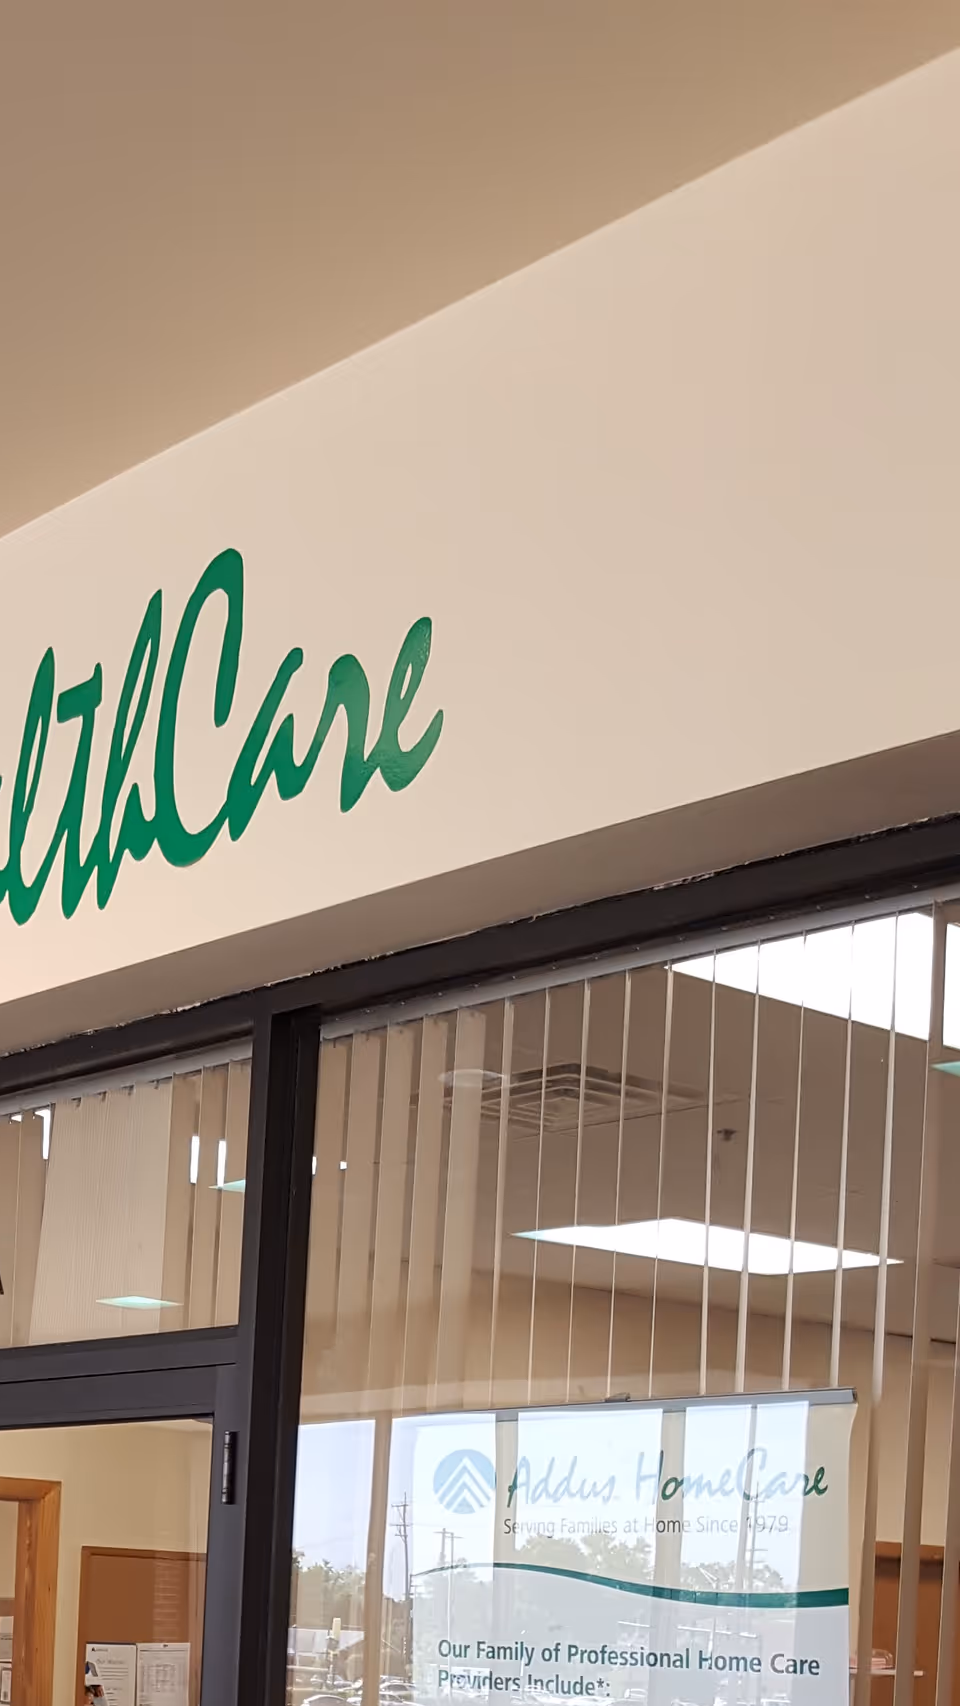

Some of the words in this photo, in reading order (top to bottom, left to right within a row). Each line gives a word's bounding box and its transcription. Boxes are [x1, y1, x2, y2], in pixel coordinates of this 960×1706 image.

[507, 1455, 617, 1508] Addus
[635, 1447, 828, 1505] HomeCare
[503, 1518, 555, 1538] Serving
[561, 1517, 617, 1534] Families
[623, 1519, 638, 1534] at
[644, 1516, 691, 1534] Home
[696, 1515, 738, 1533] Since
[746, 1515, 789, 1534] 1979
[438, 1639, 470, 1659] Our
[476, 1641, 535, 1666] Family
[541, 1642, 561, 1662] of
[567, 1644, 690, 1669] Professional
[698, 1650, 762, 1673] Home
[770, 1653, 820, 1676] Care
[438, 1669, 521, 1692] Providers
